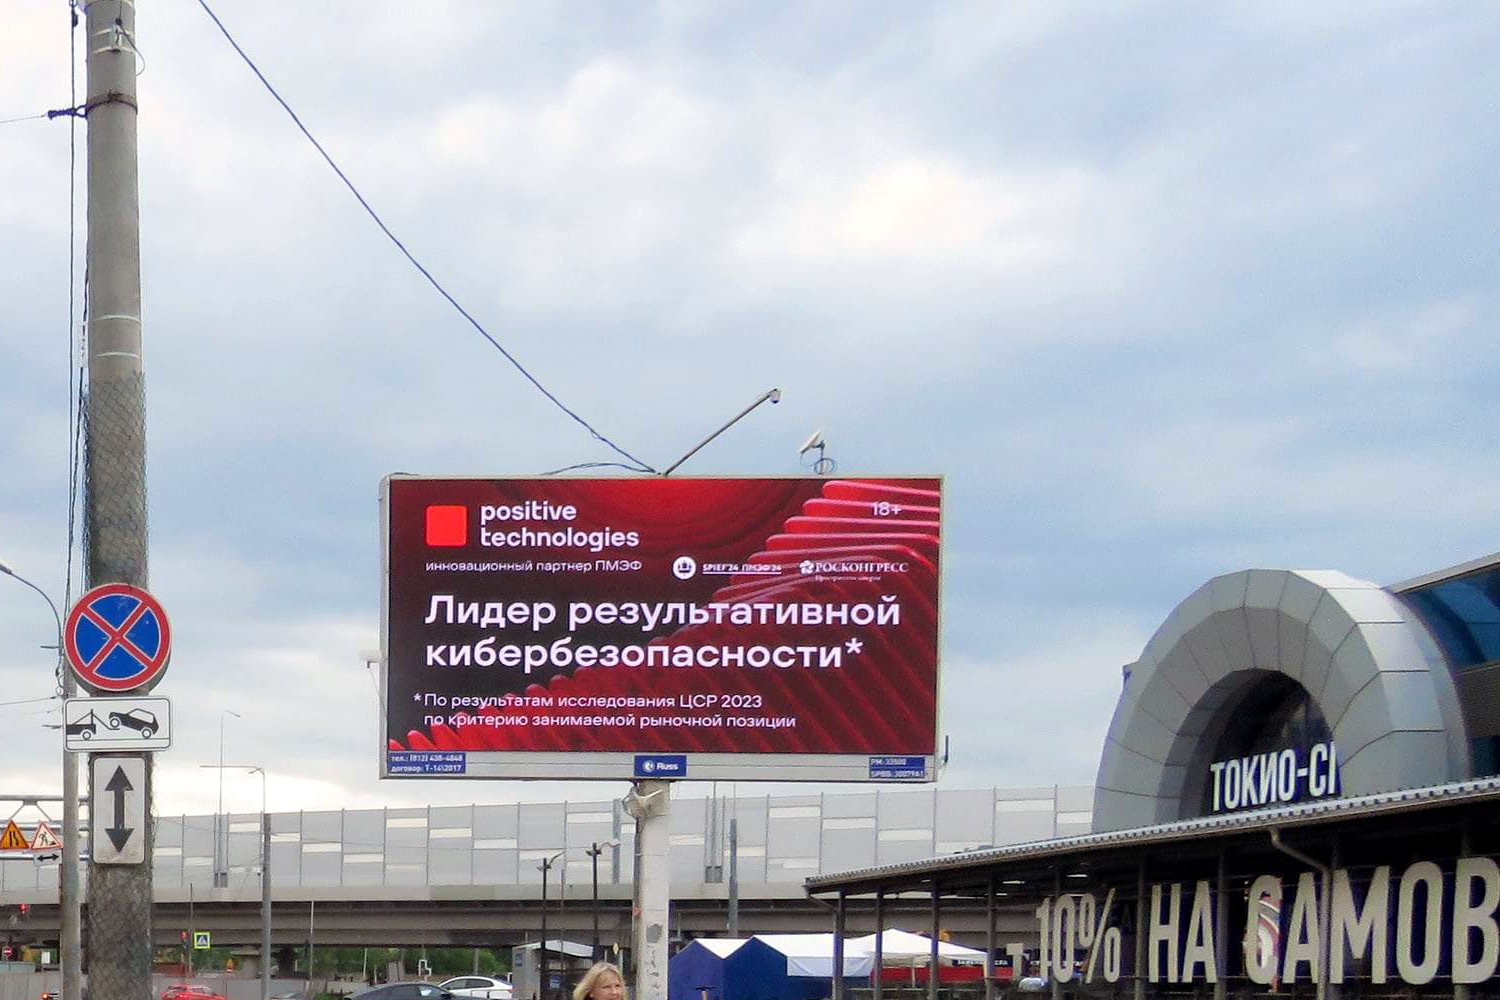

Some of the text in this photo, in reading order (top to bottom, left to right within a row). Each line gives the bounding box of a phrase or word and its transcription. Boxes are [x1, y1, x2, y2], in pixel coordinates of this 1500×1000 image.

[480, 501, 577, 525] positive
[871, 502, 902, 516] 18+
[480, 527, 640, 552] technologies
[425, 560, 643, 574] инновационный партнер ПМЭФ
[814, 561, 909, 574] РОСКОНГРЕСС
[425, 595, 900, 631] Лидер результативной
[451, 697, 554, 709] результатам
[557, 697, 675, 709] исследования
[679, 694, 718, 710] ЦСР
[721, 694, 763, 708] 2023
[424, 713, 797, 730] по критерию занимаемой рыночной позиции
[656, 762, 679, 771] Russ
[1149, 880, 1218, 984] НА
